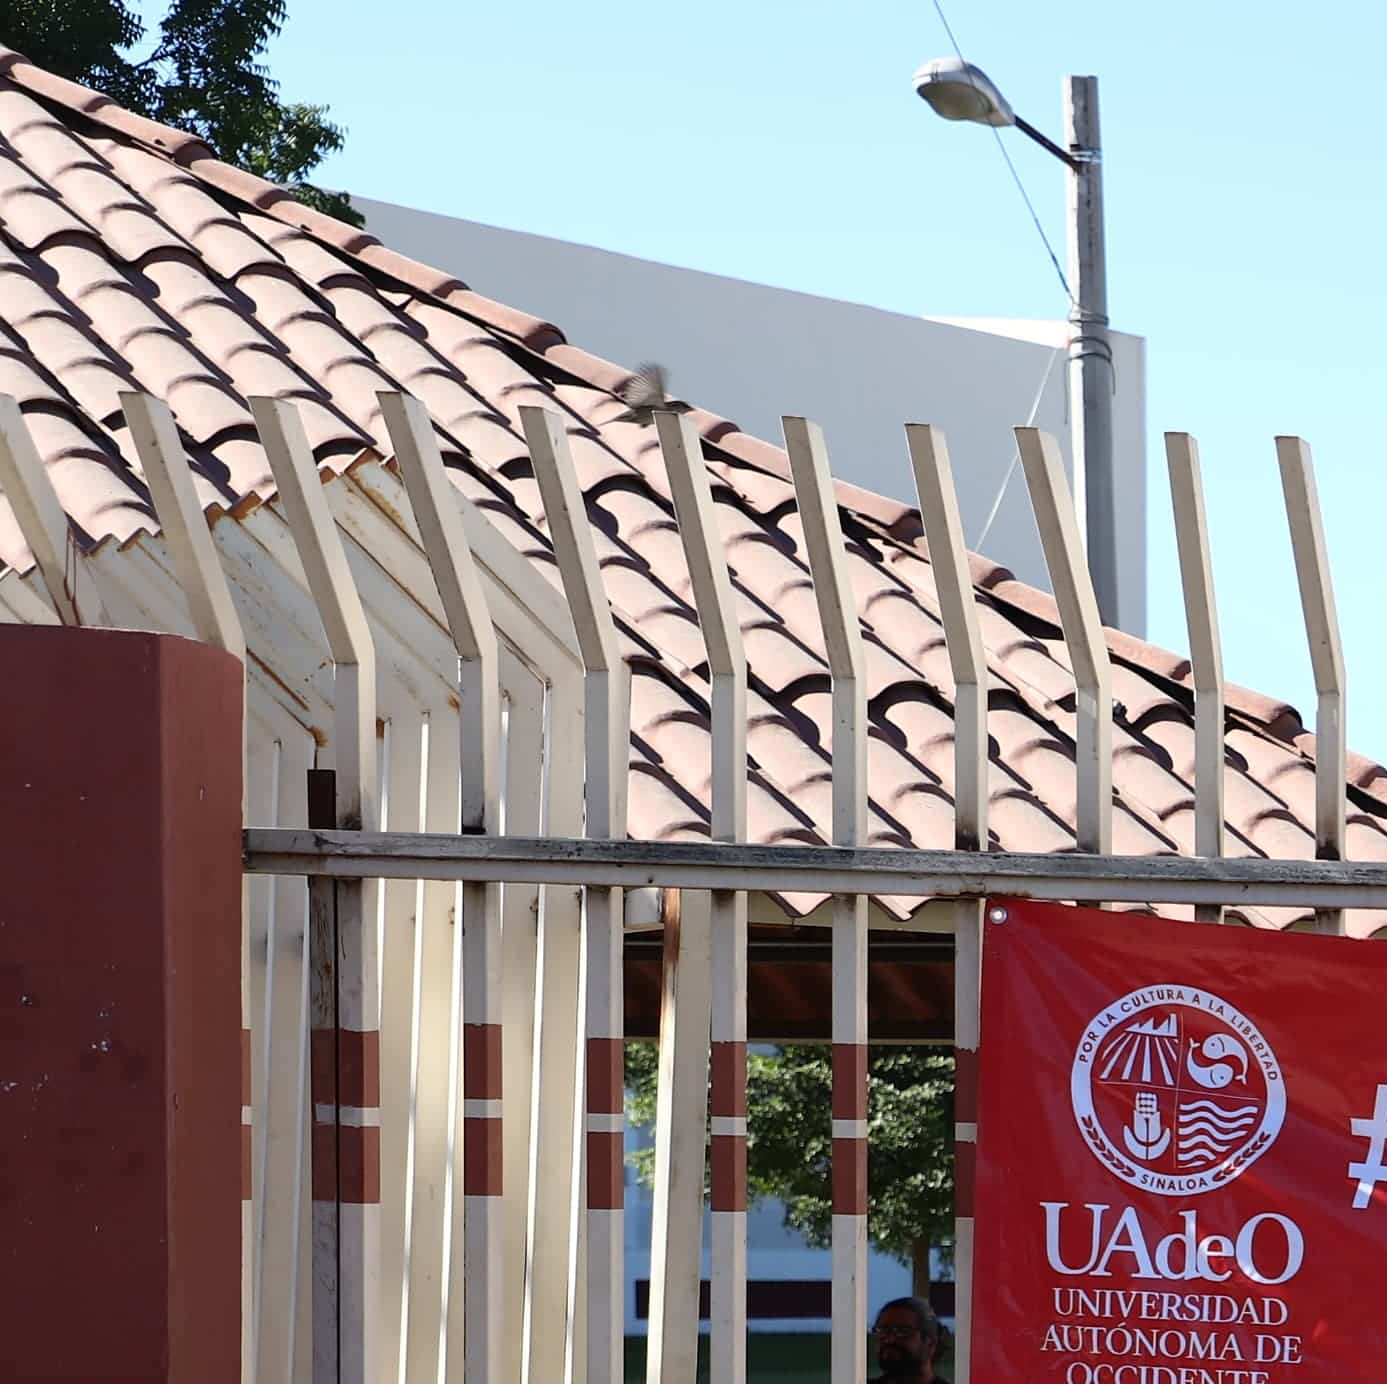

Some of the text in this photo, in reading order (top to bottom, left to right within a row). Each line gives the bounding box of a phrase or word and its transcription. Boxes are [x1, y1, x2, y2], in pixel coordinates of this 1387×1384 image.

[1079, 989, 1279, 1081] POR LA CULTURA A LA LIBERTAD
[1140, 1174, 1209, 1191] SINALOA
[1039, 1201, 1305, 1285] UAdeO
[1052, 1287, 1288, 1326] UNIVERSIDAD
[1039, 1322, 1303, 1364] AUTÓNOMA DE
